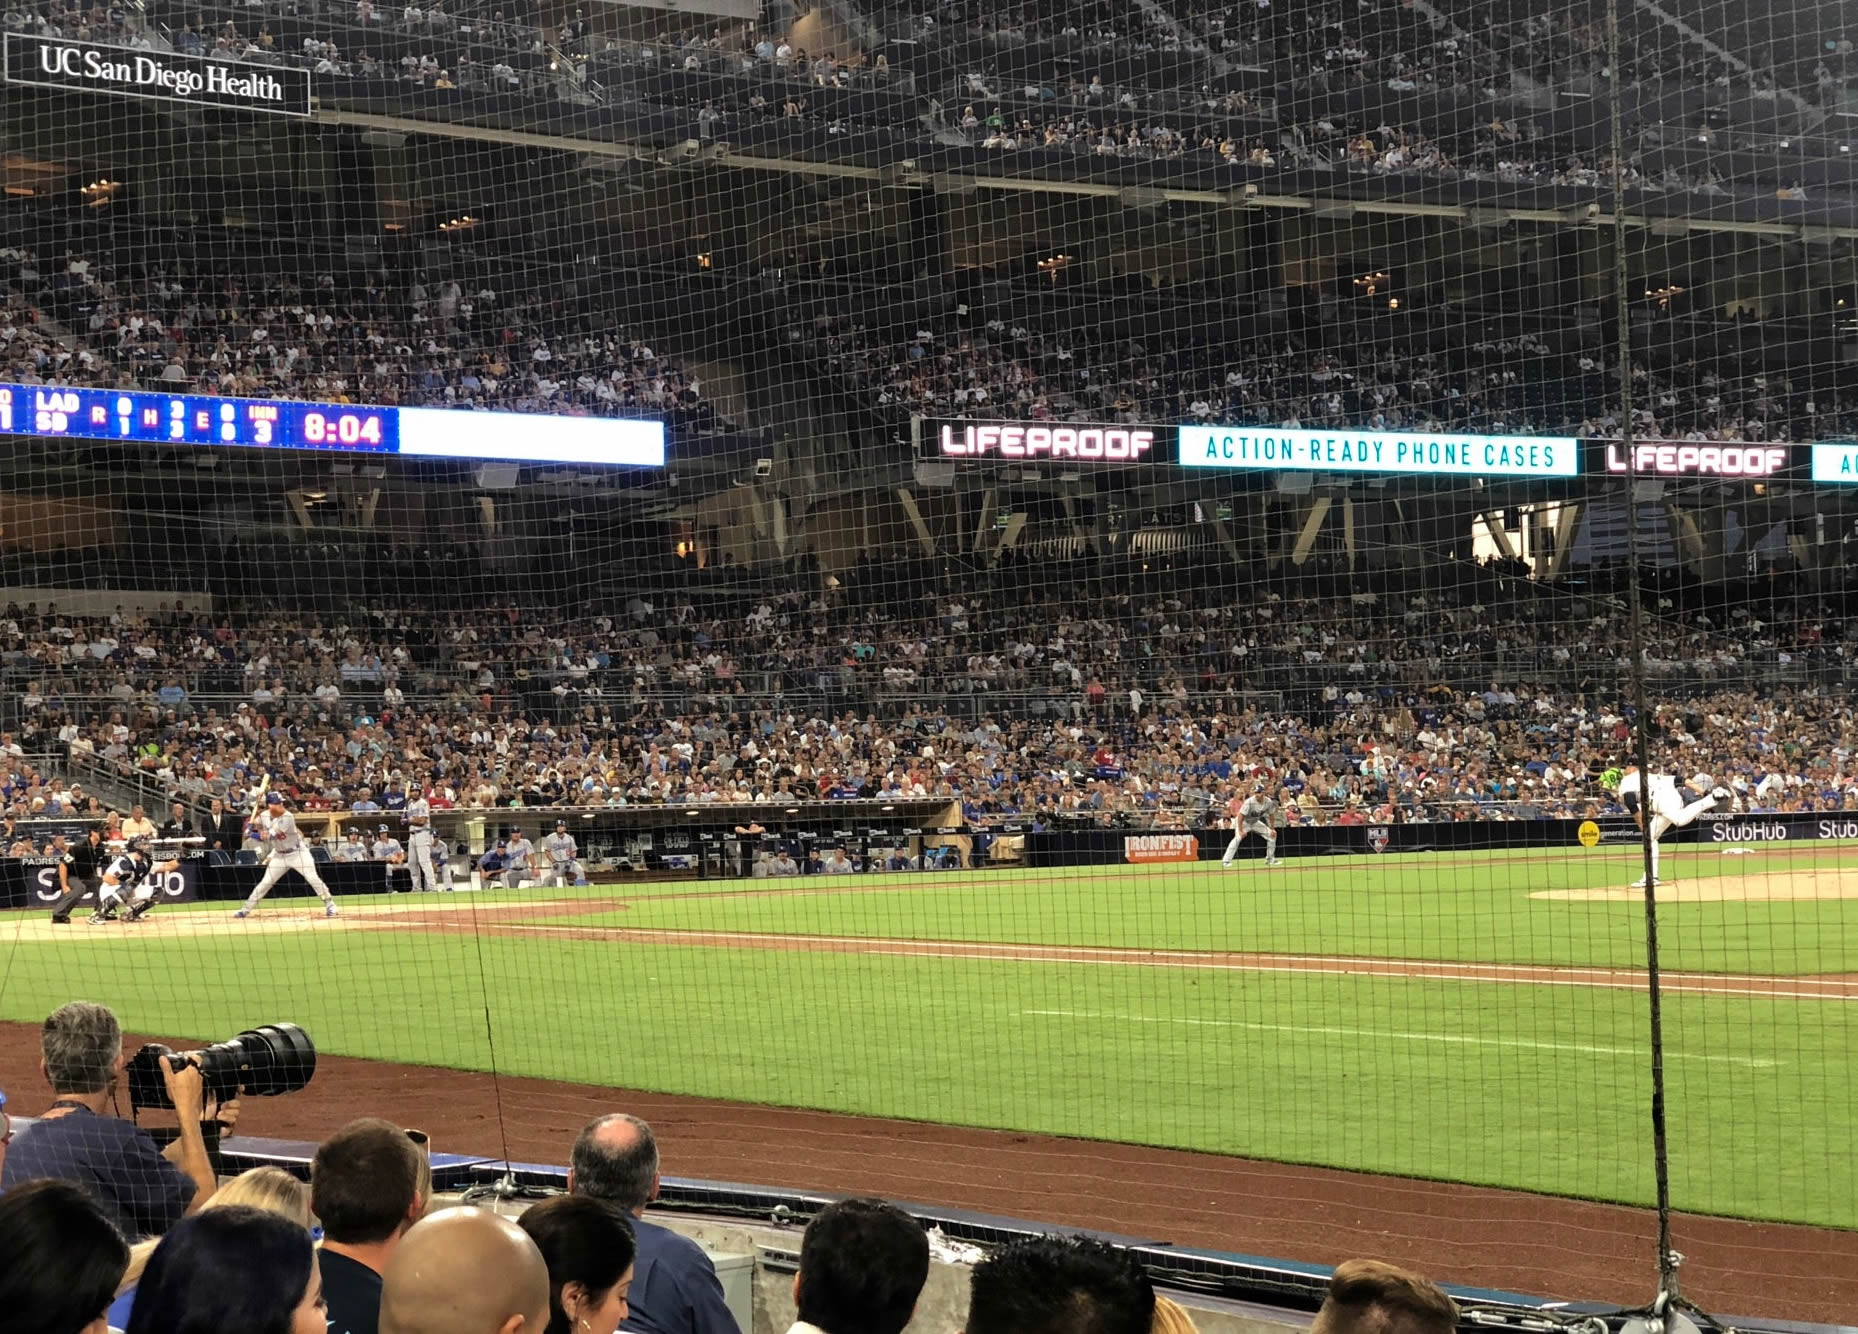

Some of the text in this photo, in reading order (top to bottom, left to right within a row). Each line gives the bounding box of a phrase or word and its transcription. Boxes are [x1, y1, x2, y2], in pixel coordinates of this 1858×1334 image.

[39, 45, 283, 100] UC San Diego Health
[36, 391, 80, 413] LAD
[36, 411, 68, 432] SD
[91, 406, 210, 429] R H E
[118, 416, 130, 436] 1
[304, 412, 381, 445] 8:04
[253, 419, 272, 444] 3
[942, 425, 1155, 459] LIFEPROOF
[1206, 435, 1554, 468] ACTION-READY PHONE CASES
[1712, 821, 1787, 842] StubHub
